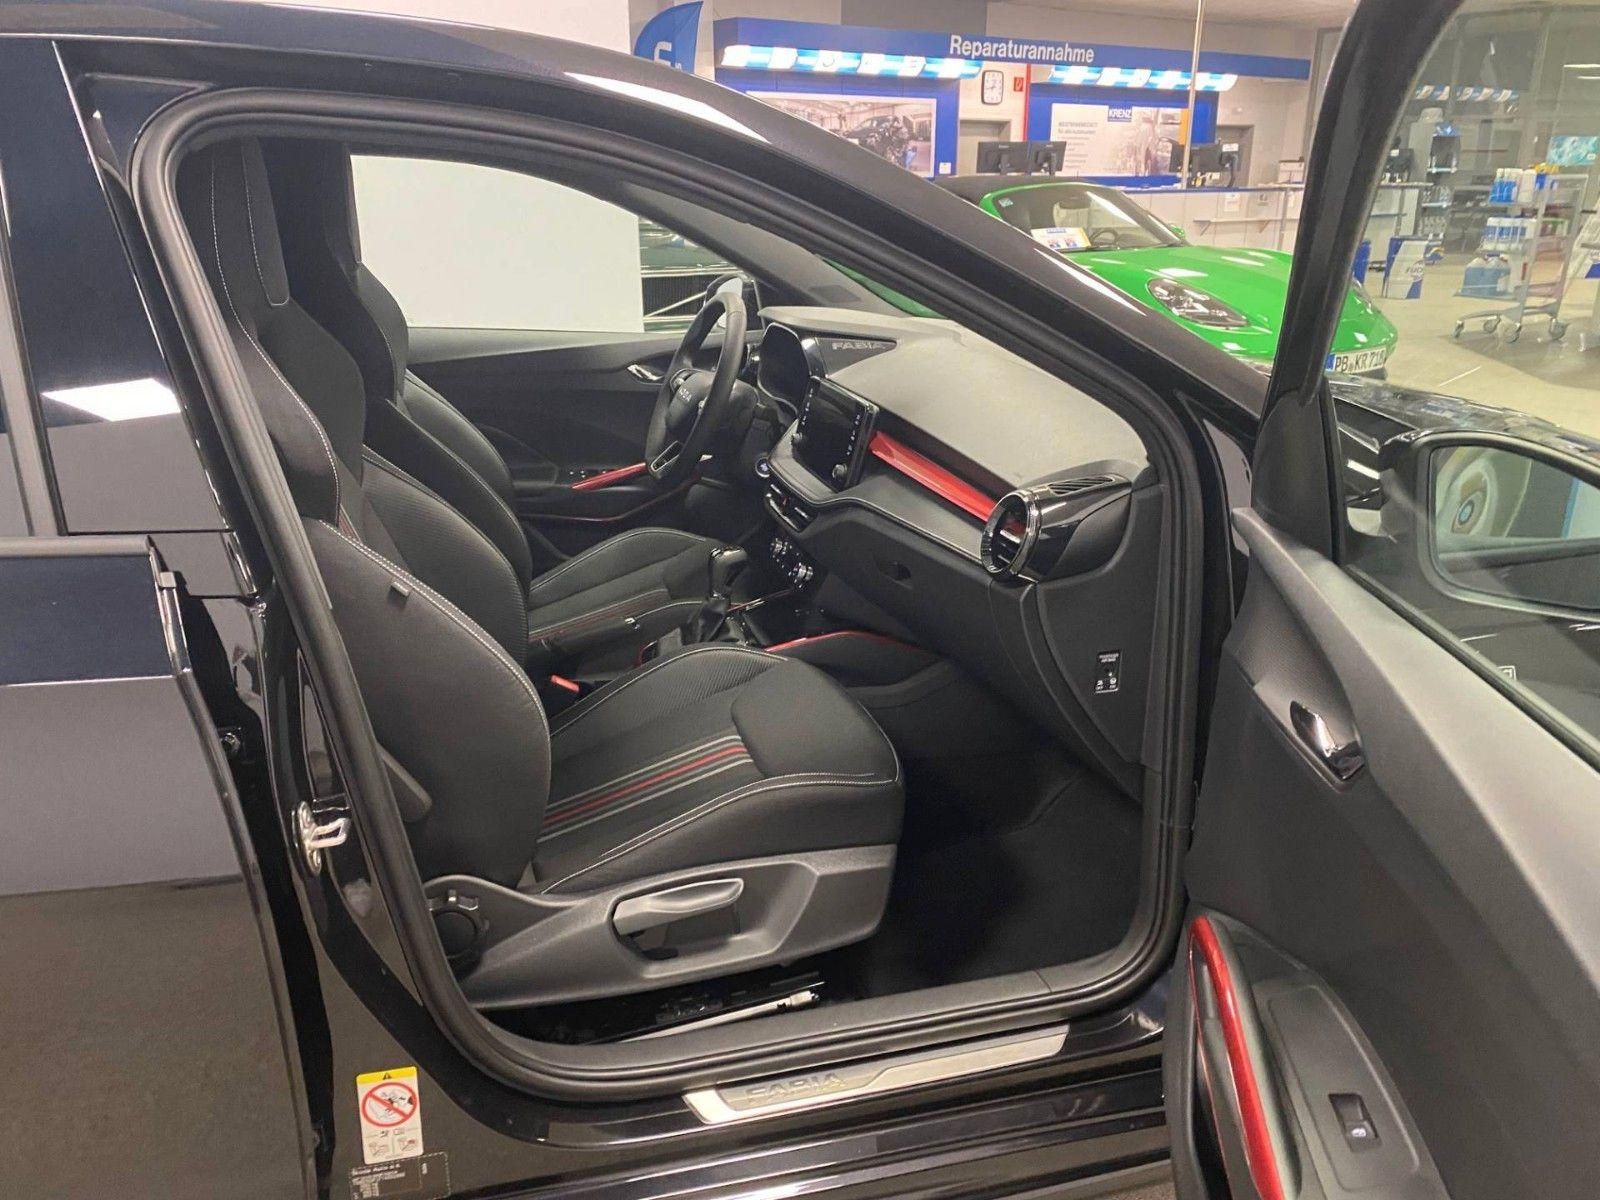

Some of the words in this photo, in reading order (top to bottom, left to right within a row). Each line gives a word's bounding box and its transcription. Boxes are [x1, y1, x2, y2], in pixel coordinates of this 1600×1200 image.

[949, 34, 1094, 62] Reparaturannahme
[1109, 108, 1132, 119] KRENZ
[1335, 356, 1349, 372] PB
[1354, 353, 1368, 370] KR
